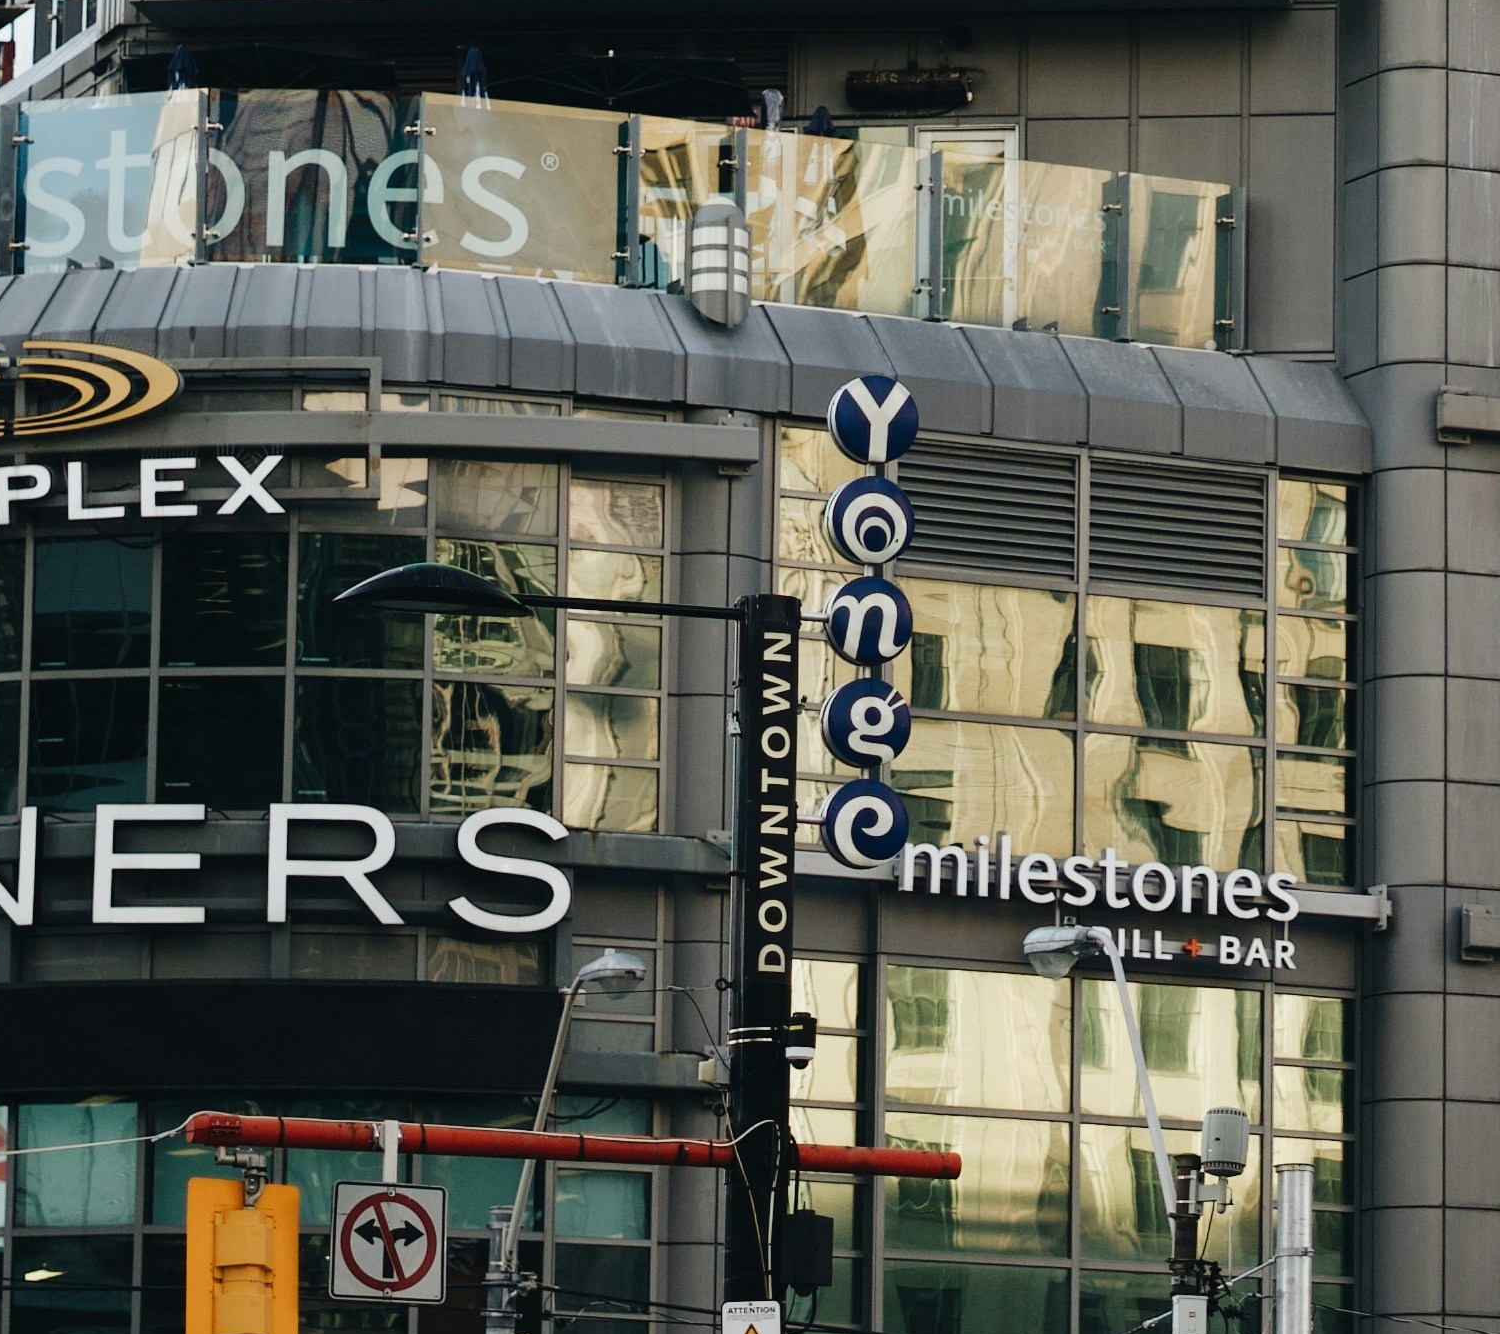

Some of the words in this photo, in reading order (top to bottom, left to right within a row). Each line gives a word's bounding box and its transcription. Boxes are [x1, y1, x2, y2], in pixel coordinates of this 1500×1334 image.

[822, 375, 918, 868] Yonge
[757, 631, 793, 973] DOWNTOWN
[901, 832, 1301, 922] milestones
[1219, 934, 1297, 970] BAR
